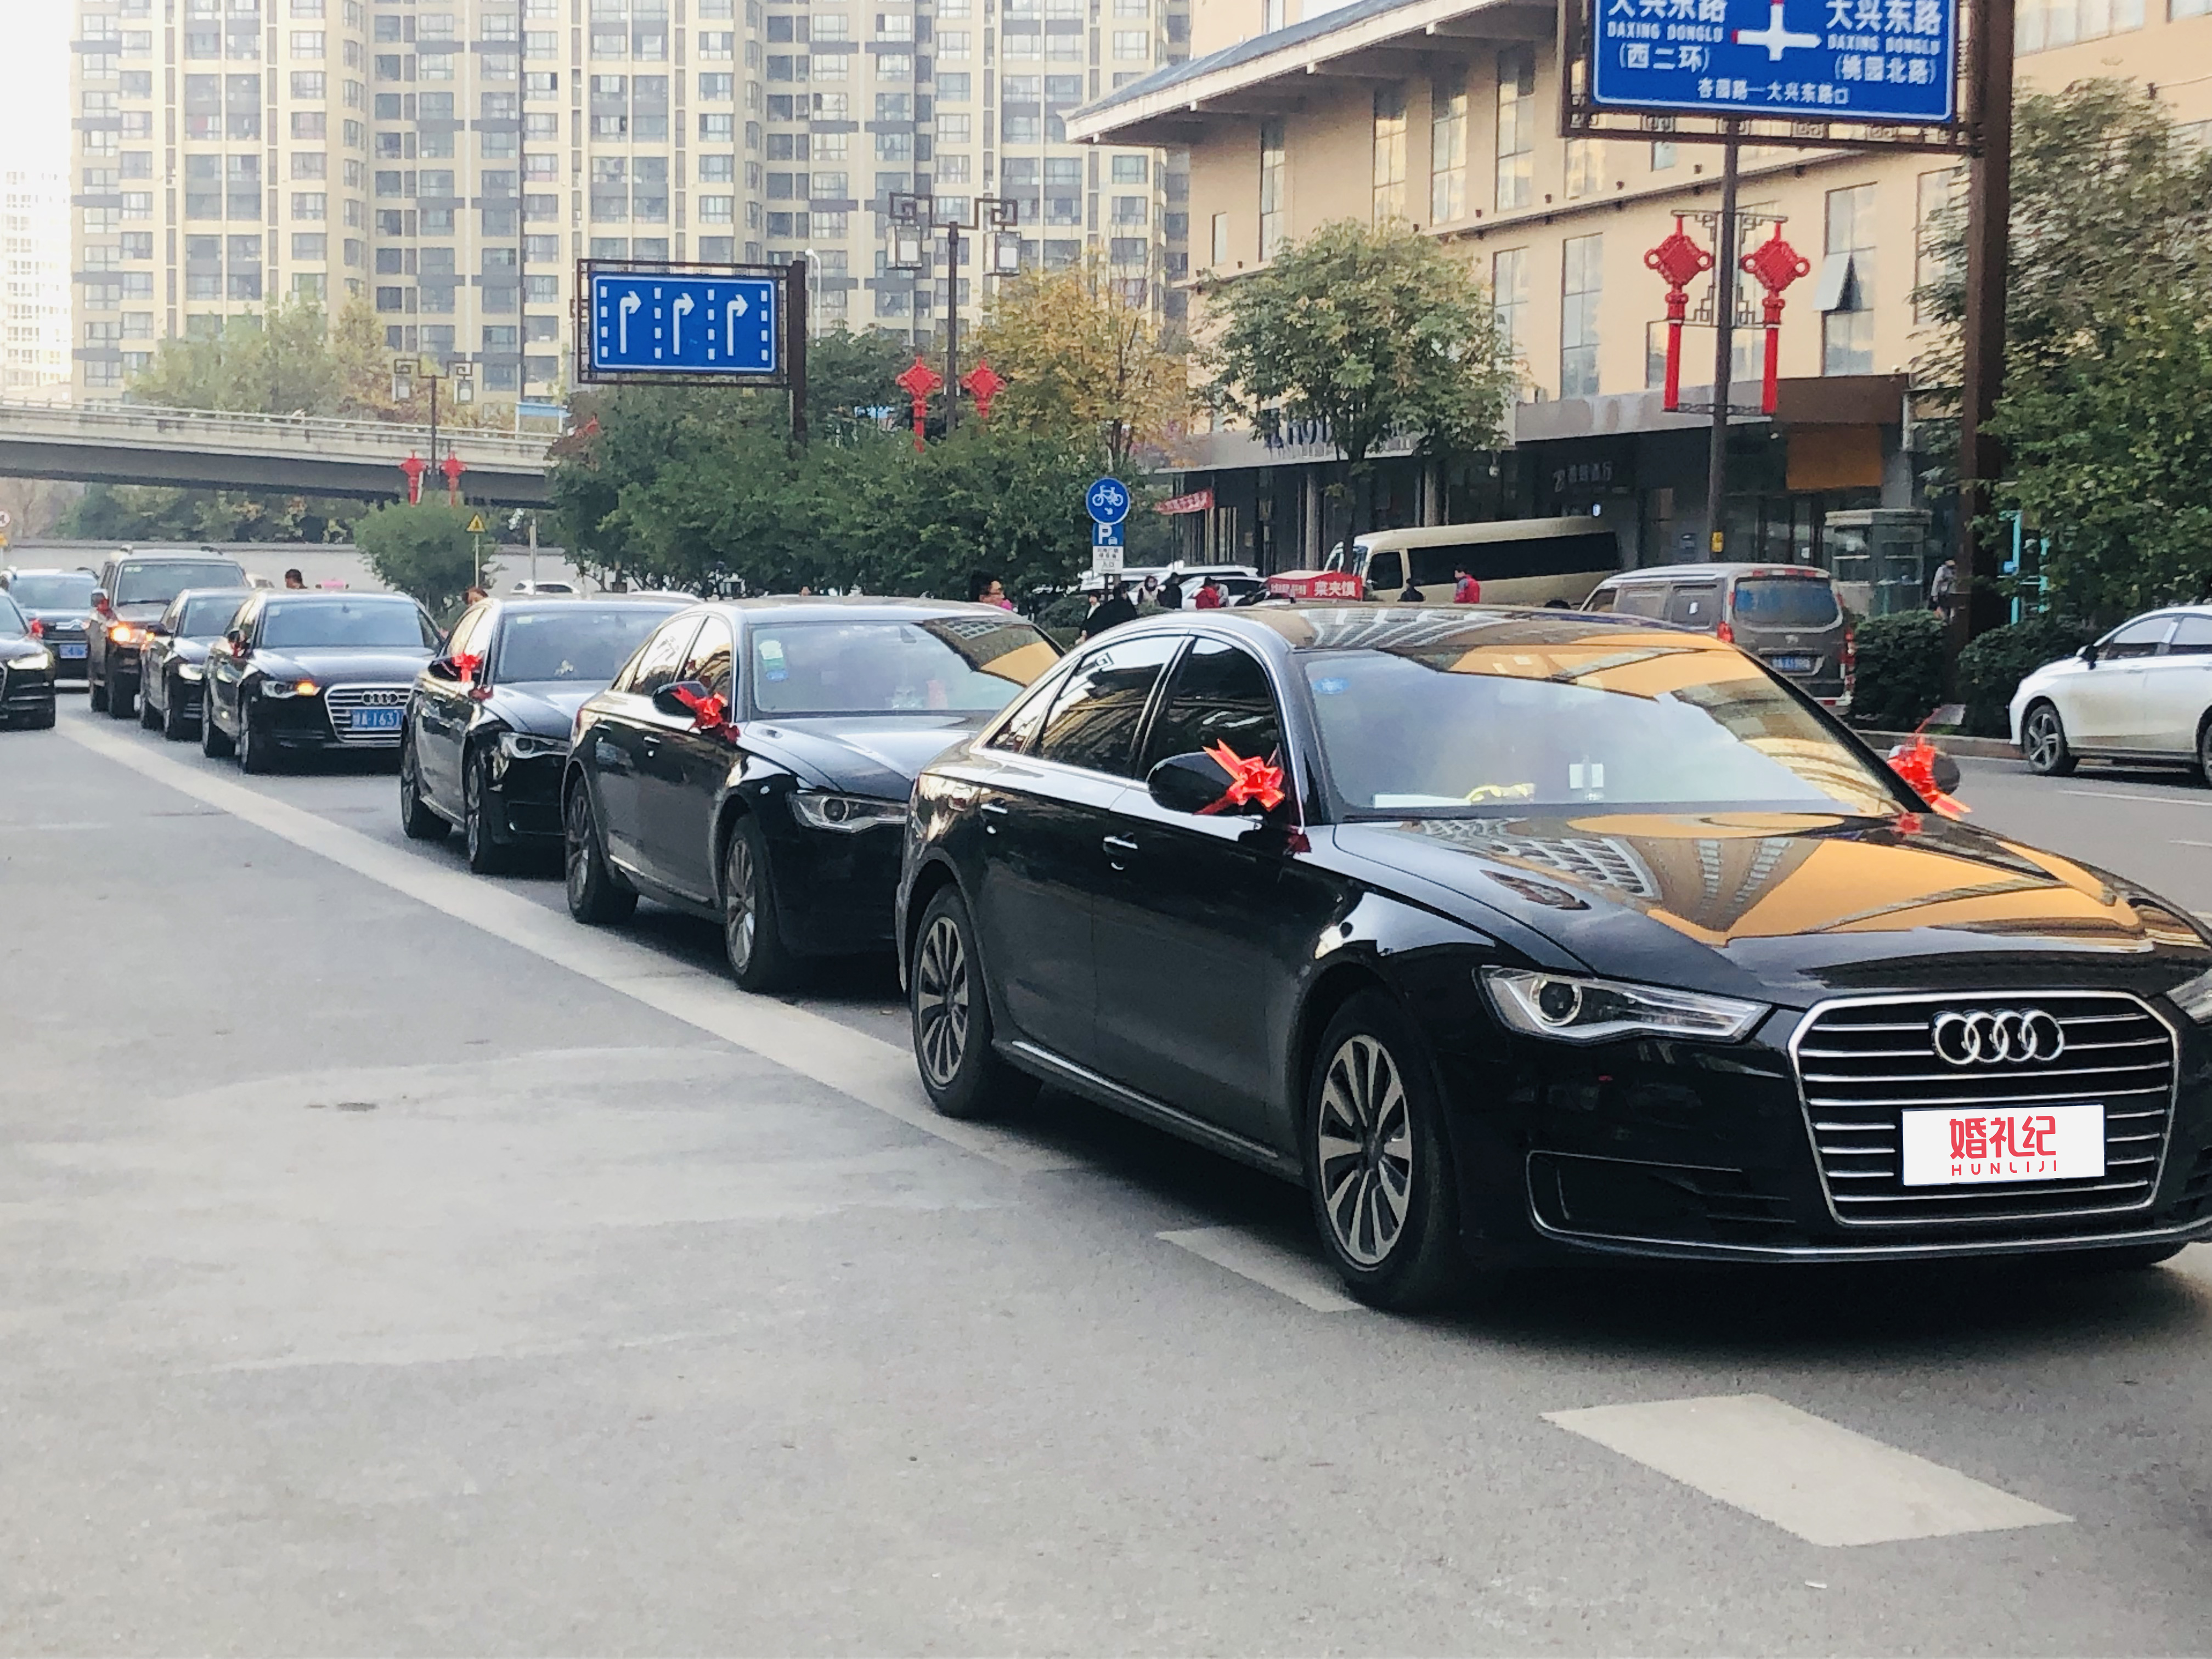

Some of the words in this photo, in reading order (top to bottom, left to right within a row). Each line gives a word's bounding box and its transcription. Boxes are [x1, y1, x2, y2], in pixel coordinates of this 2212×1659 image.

[1607, 21, 1660, 40] DAXING
[1667, 24, 1724, 43] DONGLU
[1825, 0, 1943, 36] 大兴东路
